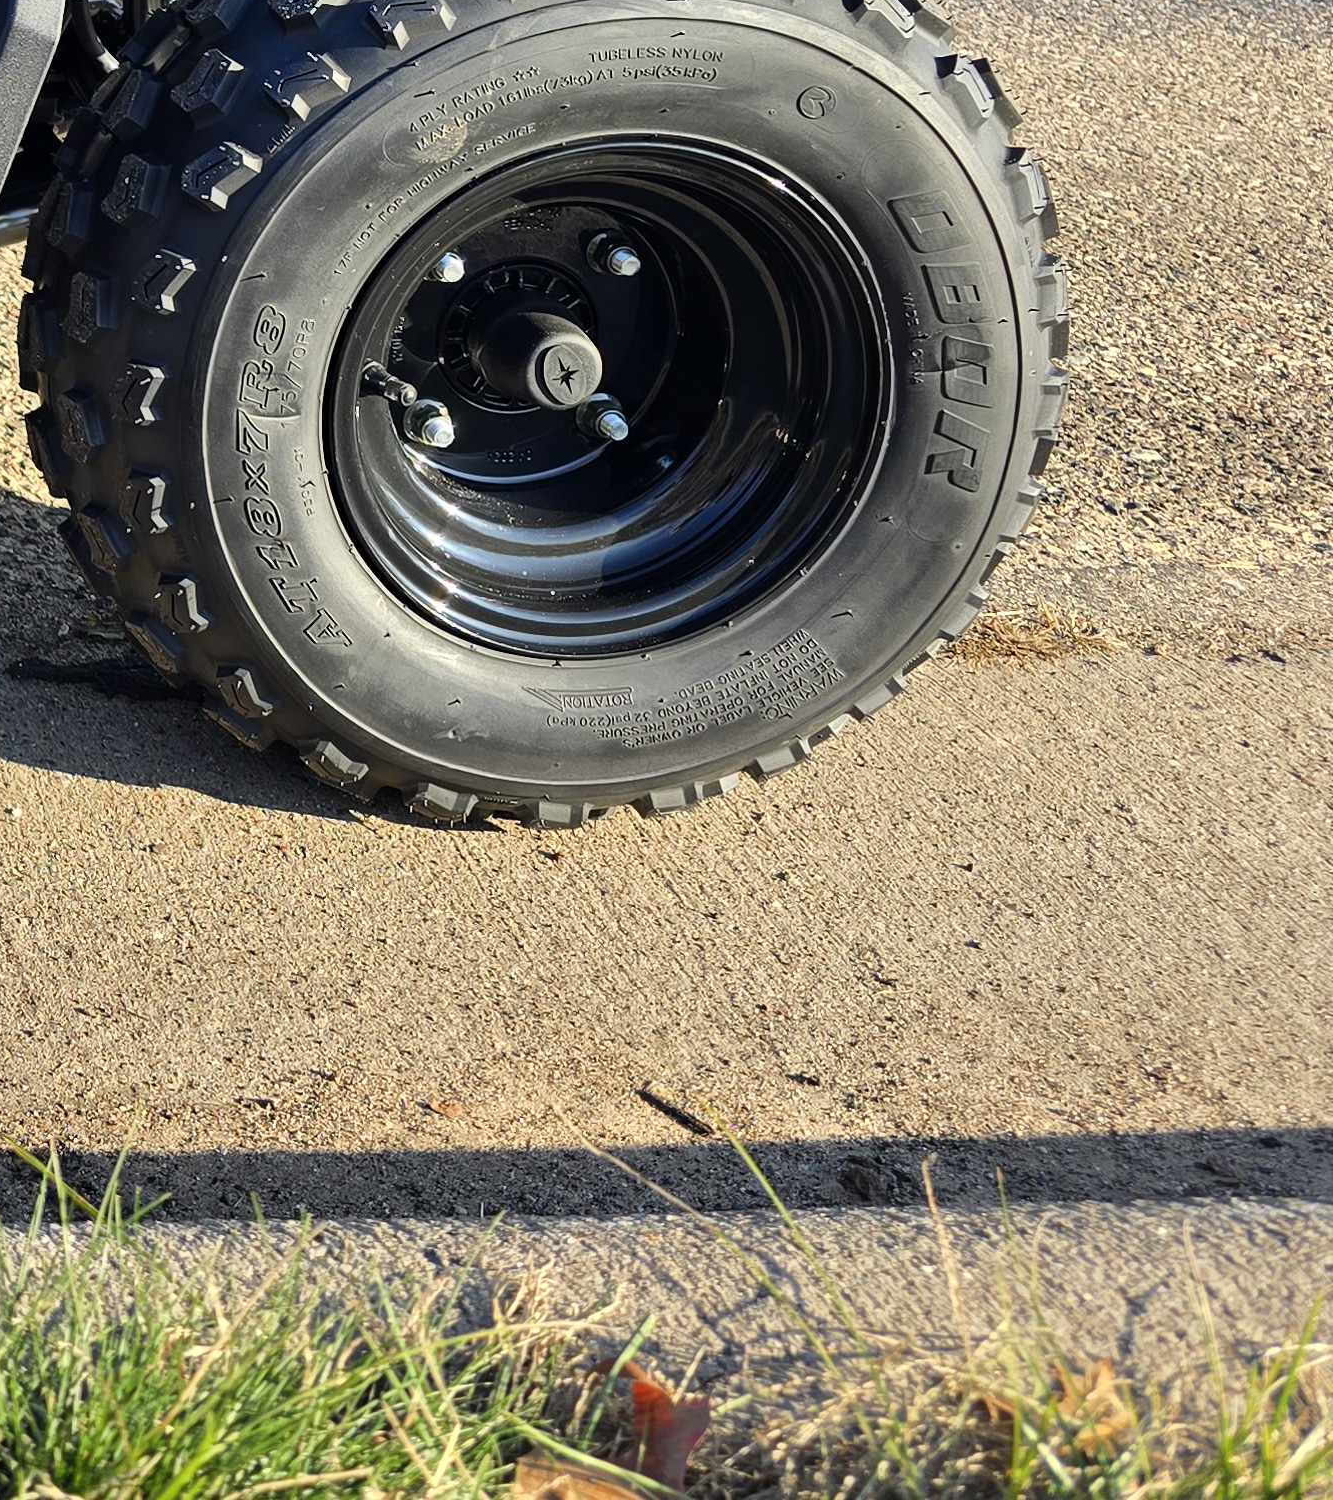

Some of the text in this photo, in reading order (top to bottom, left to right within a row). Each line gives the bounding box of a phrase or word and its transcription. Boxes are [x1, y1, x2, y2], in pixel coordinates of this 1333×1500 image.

[587, 47, 725, 63] TUBELESS NYLON
[406, 75, 506, 135] 4 PLY RATING
[451, 99, 494, 128] LOAD
[595, 67, 616, 81] AT
[351, 220, 379, 250] NOT
[376, 194, 407, 223] FOR
[404, 150, 470, 199] HIGHWAY
[471, 122, 538, 156] SERVICE
[771, 627, 809, 658] WHEN
[797, 637, 819, 656] DO
[716, 652, 772, 686] SEATING
[769, 652, 798, 675] NOT
[775, 647, 827, 685] MANUAL
[560, 694, 633, 707] ROTATION
[714, 668, 769, 701] INFLATE
[744, 679, 775, 702] FOR
[621, 656, 835, 748] SEE VEHICLE LABEL OR OWNER'S
[633, 710, 652, 723] 32
[656, 694, 711, 719] BEYOND
[669, 694, 745, 727] OPERATING
